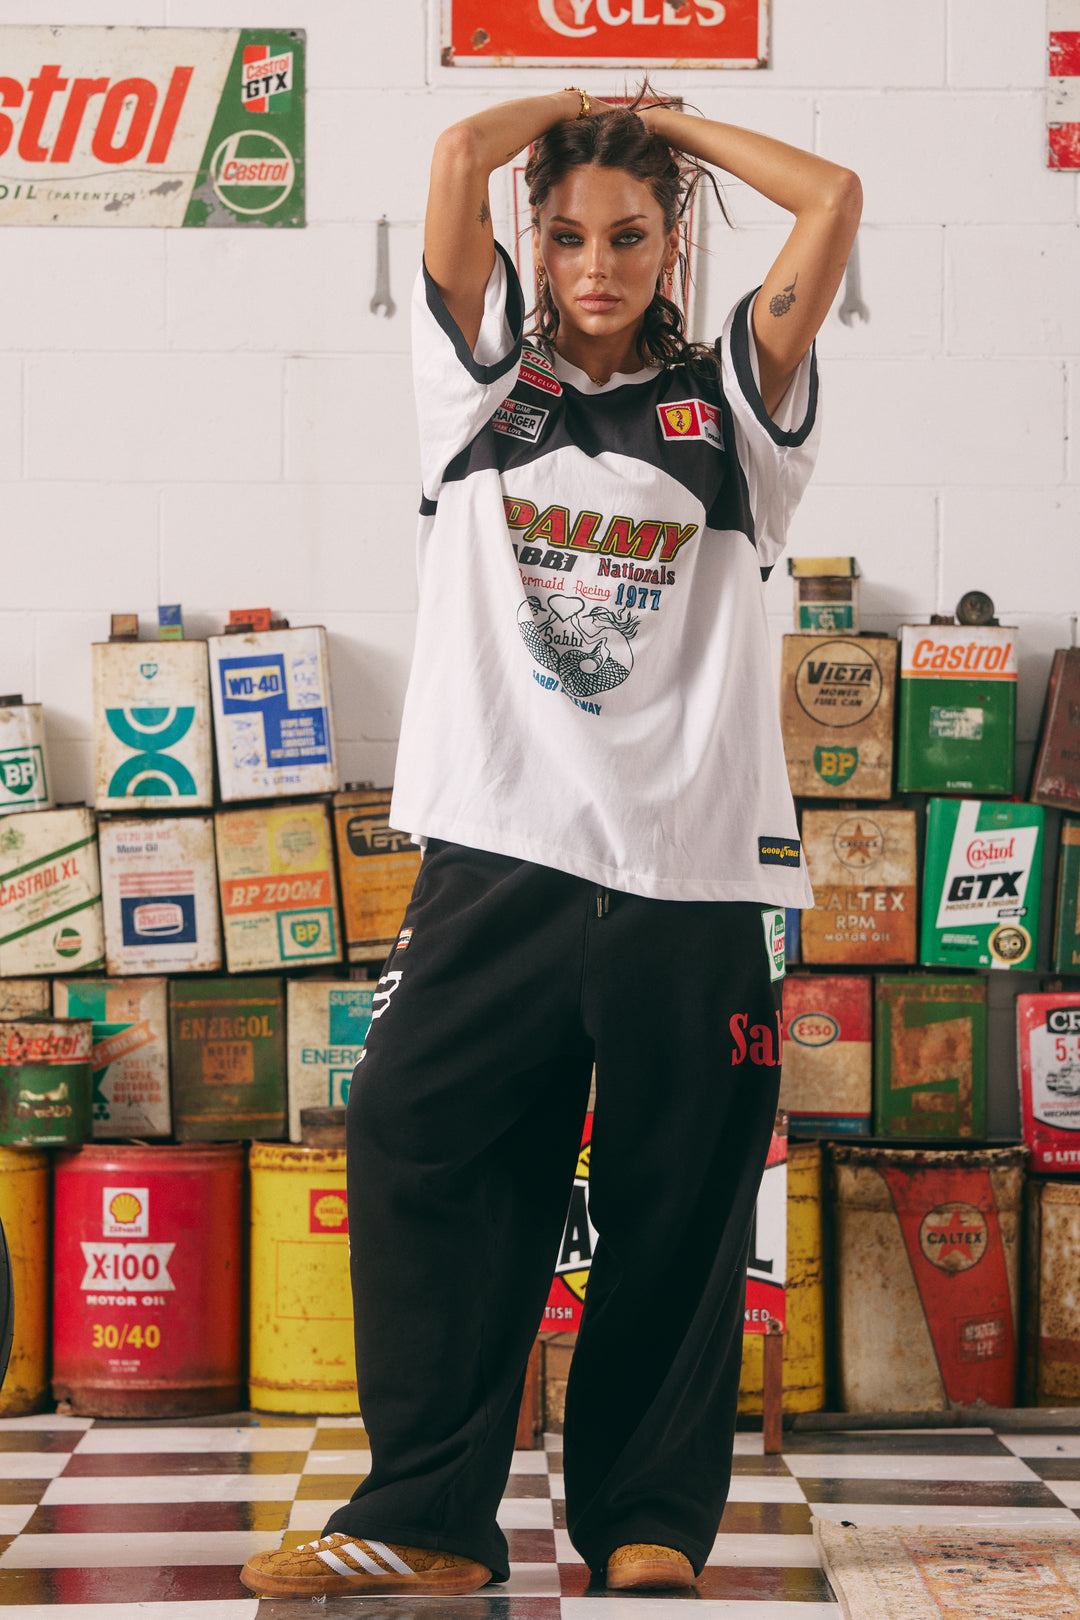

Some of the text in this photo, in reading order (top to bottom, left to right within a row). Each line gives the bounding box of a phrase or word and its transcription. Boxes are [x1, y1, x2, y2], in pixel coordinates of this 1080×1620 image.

[246, 55, 290, 80] Castrol
[246, 71, 287, 98] GTX
[223, 161, 289, 181] Castrol
[520, 369, 557, 391] OVE CLUB
[503, 401, 532, 413] THE GAME
[508, 426, 522, 435] LOVE
[598, 558, 675, 585] Nationals
[519, 568, 612, 602] ermaid Racing
[615, 583, 662, 611] 1977
[911, 639, 1012, 671] Castrol
[807, 661, 872, 684] VICTA
[229, 673, 279, 697] WD-40
[819, 688, 861, 698] MOWER
[814, 698, 863, 707] FUEL CAN
[4, 759, 34, 788] BP
[820, 752, 855, 776] BP
[966, 837, 1015, 870] Castrol
[0, 866, 60, 907] CASTROL
[61, 858, 80, 881] XL
[229, 878, 325, 907] BP ZOOM
[947, 871, 1025, 902] GTX
[813, 891, 906, 912] CALTEX
[945, 898, 1020, 911] MODERN ENGINE
[294, 923, 319, 942] BP
[835, 914, 876, 930] RPM
[824, 931, 890, 942] MOTOR OIL
[330, 992, 372, 1006] SUPER
[180, 1016, 273, 1040] ENERGOL
[7, 1034, 79, 1057] Castrol
[319, 1206, 344, 1215] SHELL
[926, 1231, 982, 1245] CALTEX
[92, 1253, 160, 1280] X-100
[86, 1295, 165, 1306] MOTOR OIL
[92, 1323, 161, 1350] 30/40
